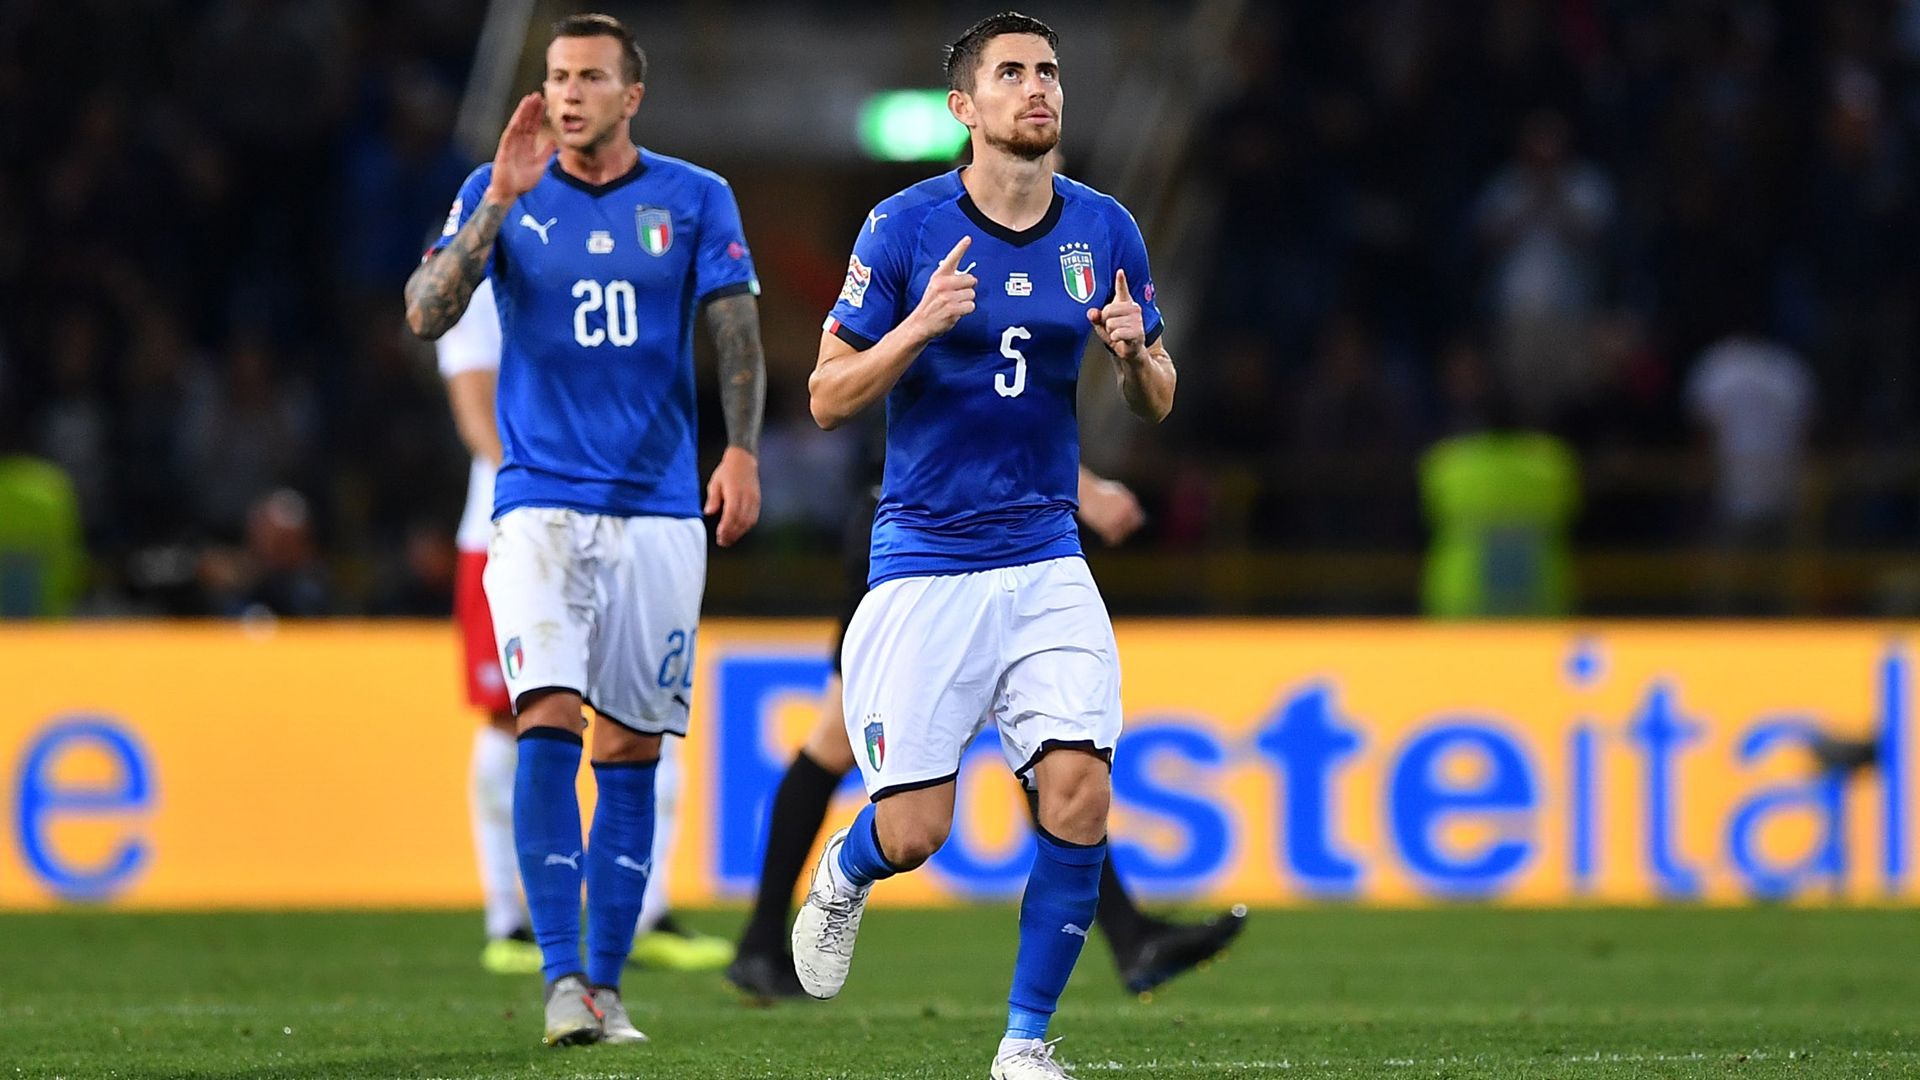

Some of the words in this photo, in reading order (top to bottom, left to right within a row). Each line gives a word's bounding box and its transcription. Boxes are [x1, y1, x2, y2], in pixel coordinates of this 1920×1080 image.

[572, 279, 638, 347] 20
[994, 326, 1031, 397] 5
[14, 712, 155, 899] e
